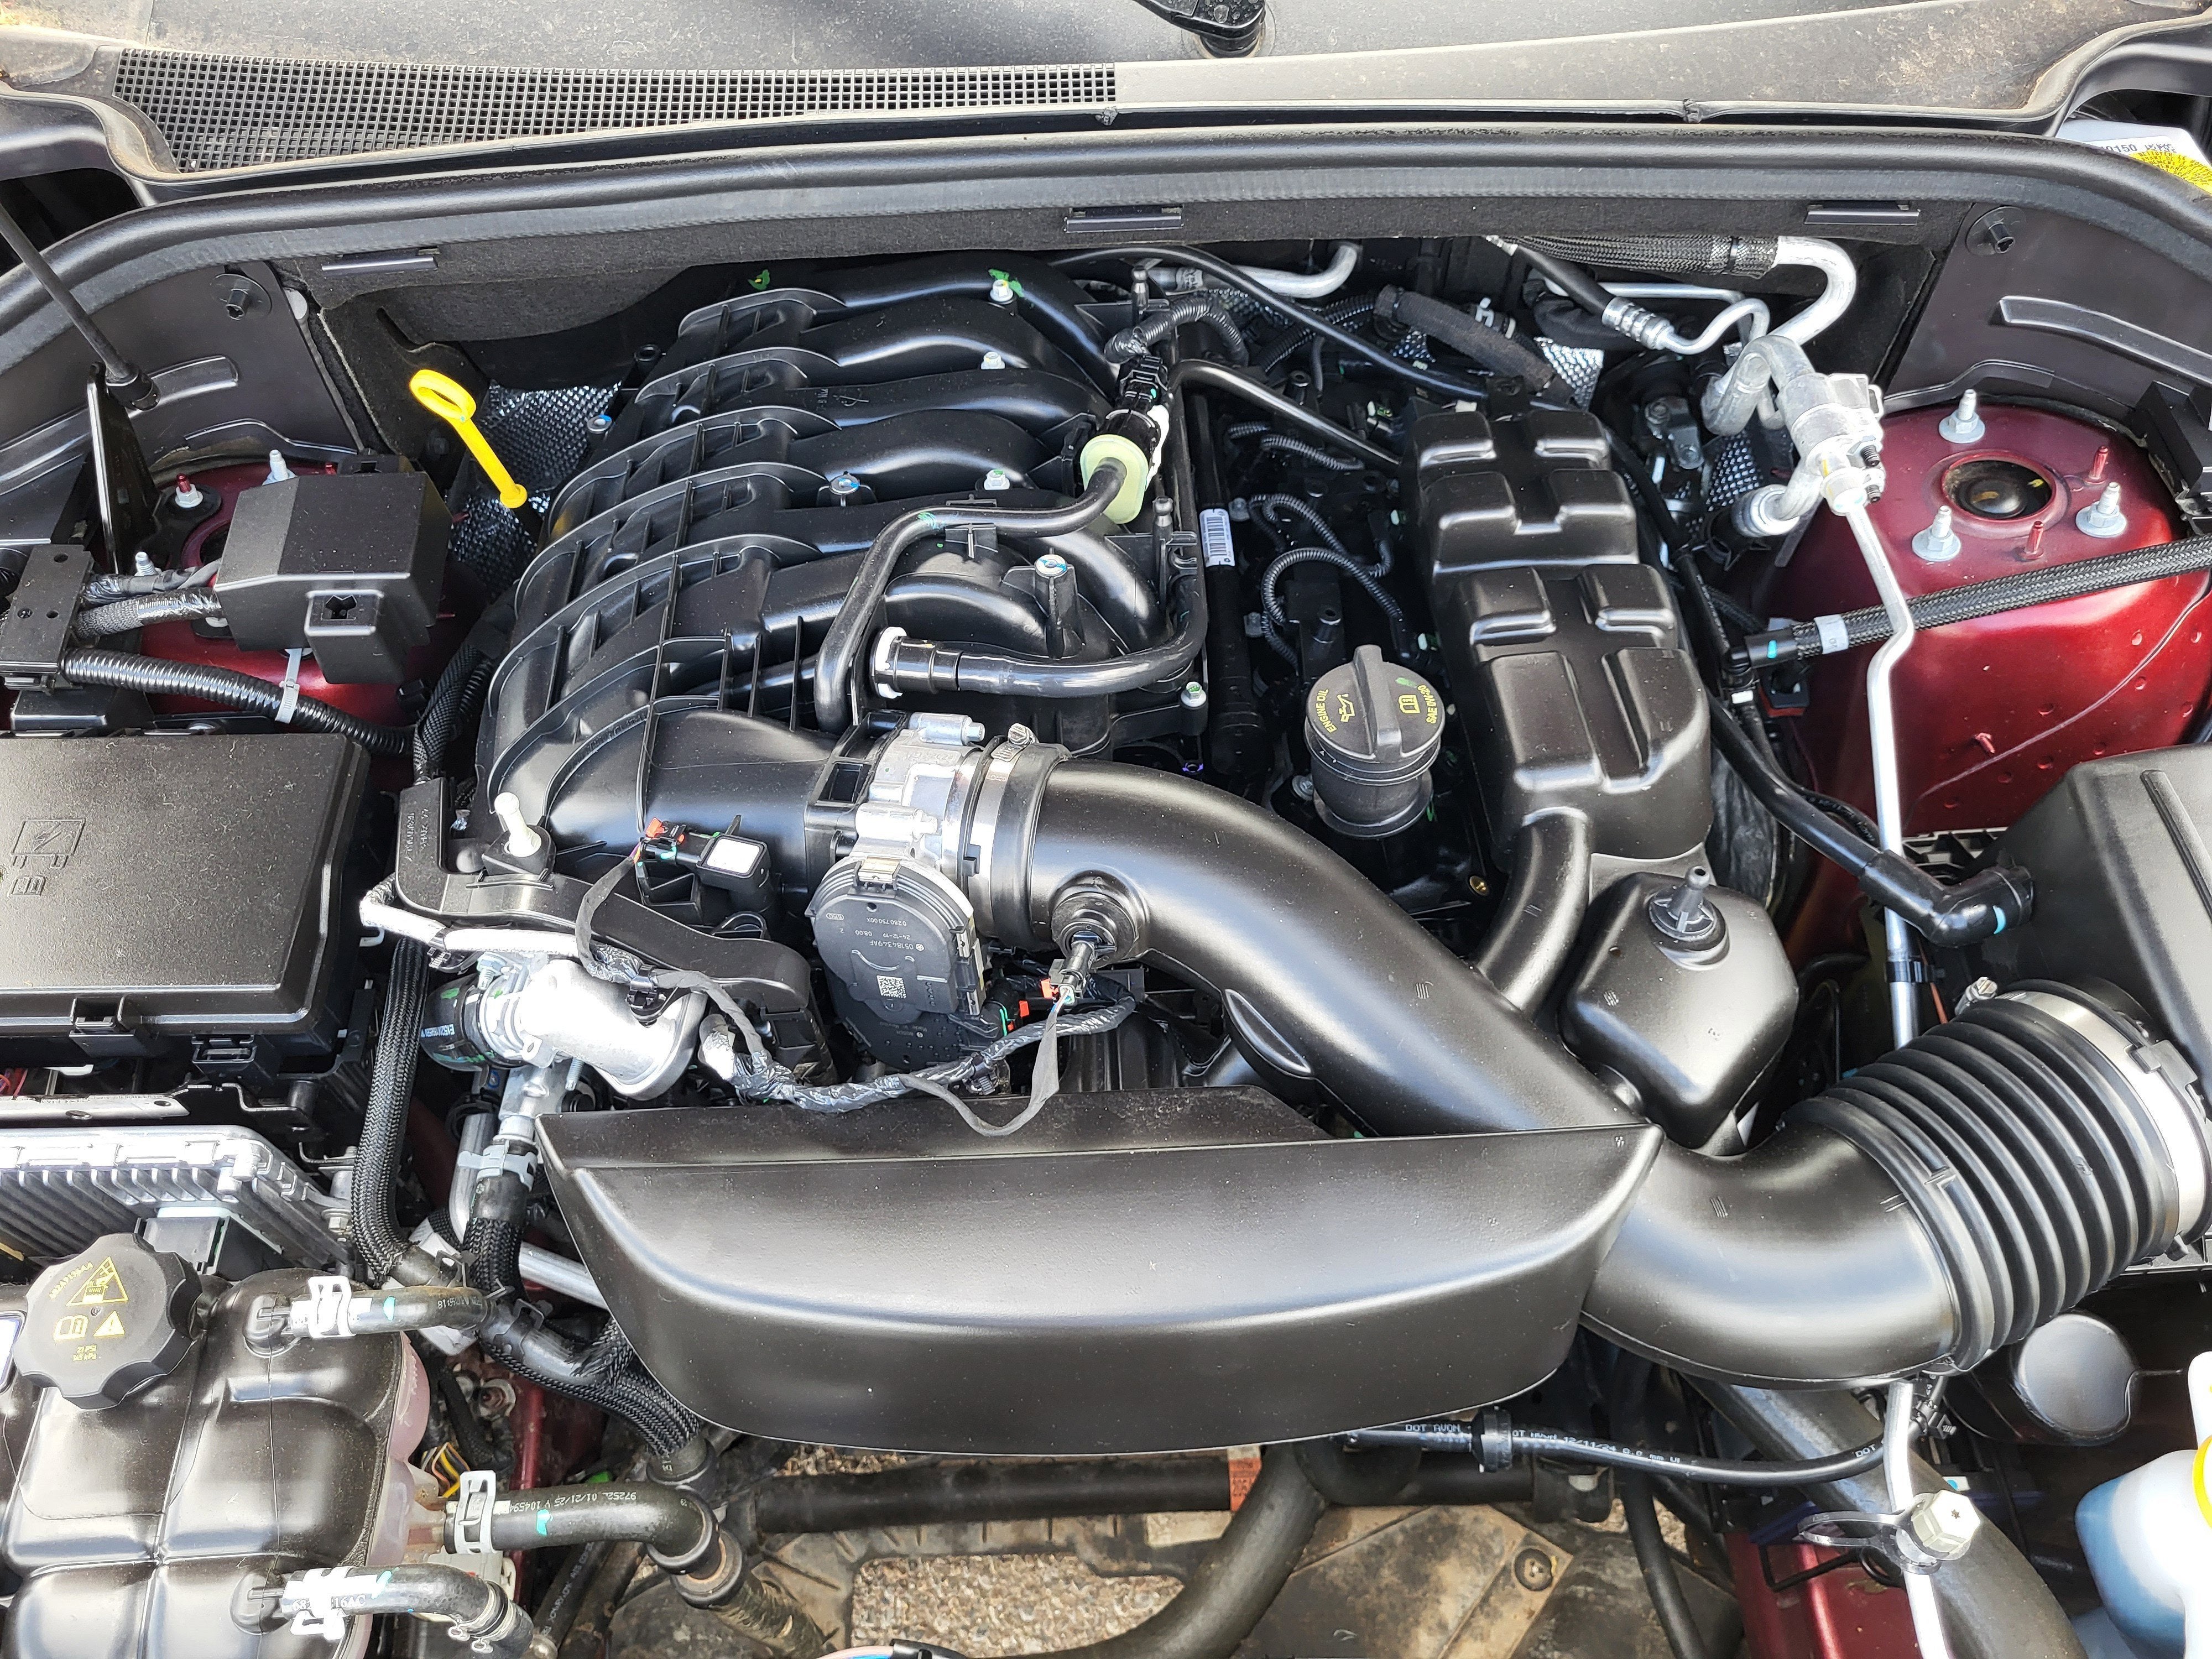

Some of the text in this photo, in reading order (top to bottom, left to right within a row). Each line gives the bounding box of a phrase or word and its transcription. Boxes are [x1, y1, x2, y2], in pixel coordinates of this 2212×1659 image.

[1316, 688, 1337, 733] ENGINE OIL
[1426, 707, 1437, 724] SAE
[1405, 1423, 1427, 1432] DOT
[1855, 1444, 1875, 1458] DOT
[554, 1493, 598, 1507] 01/21/25
